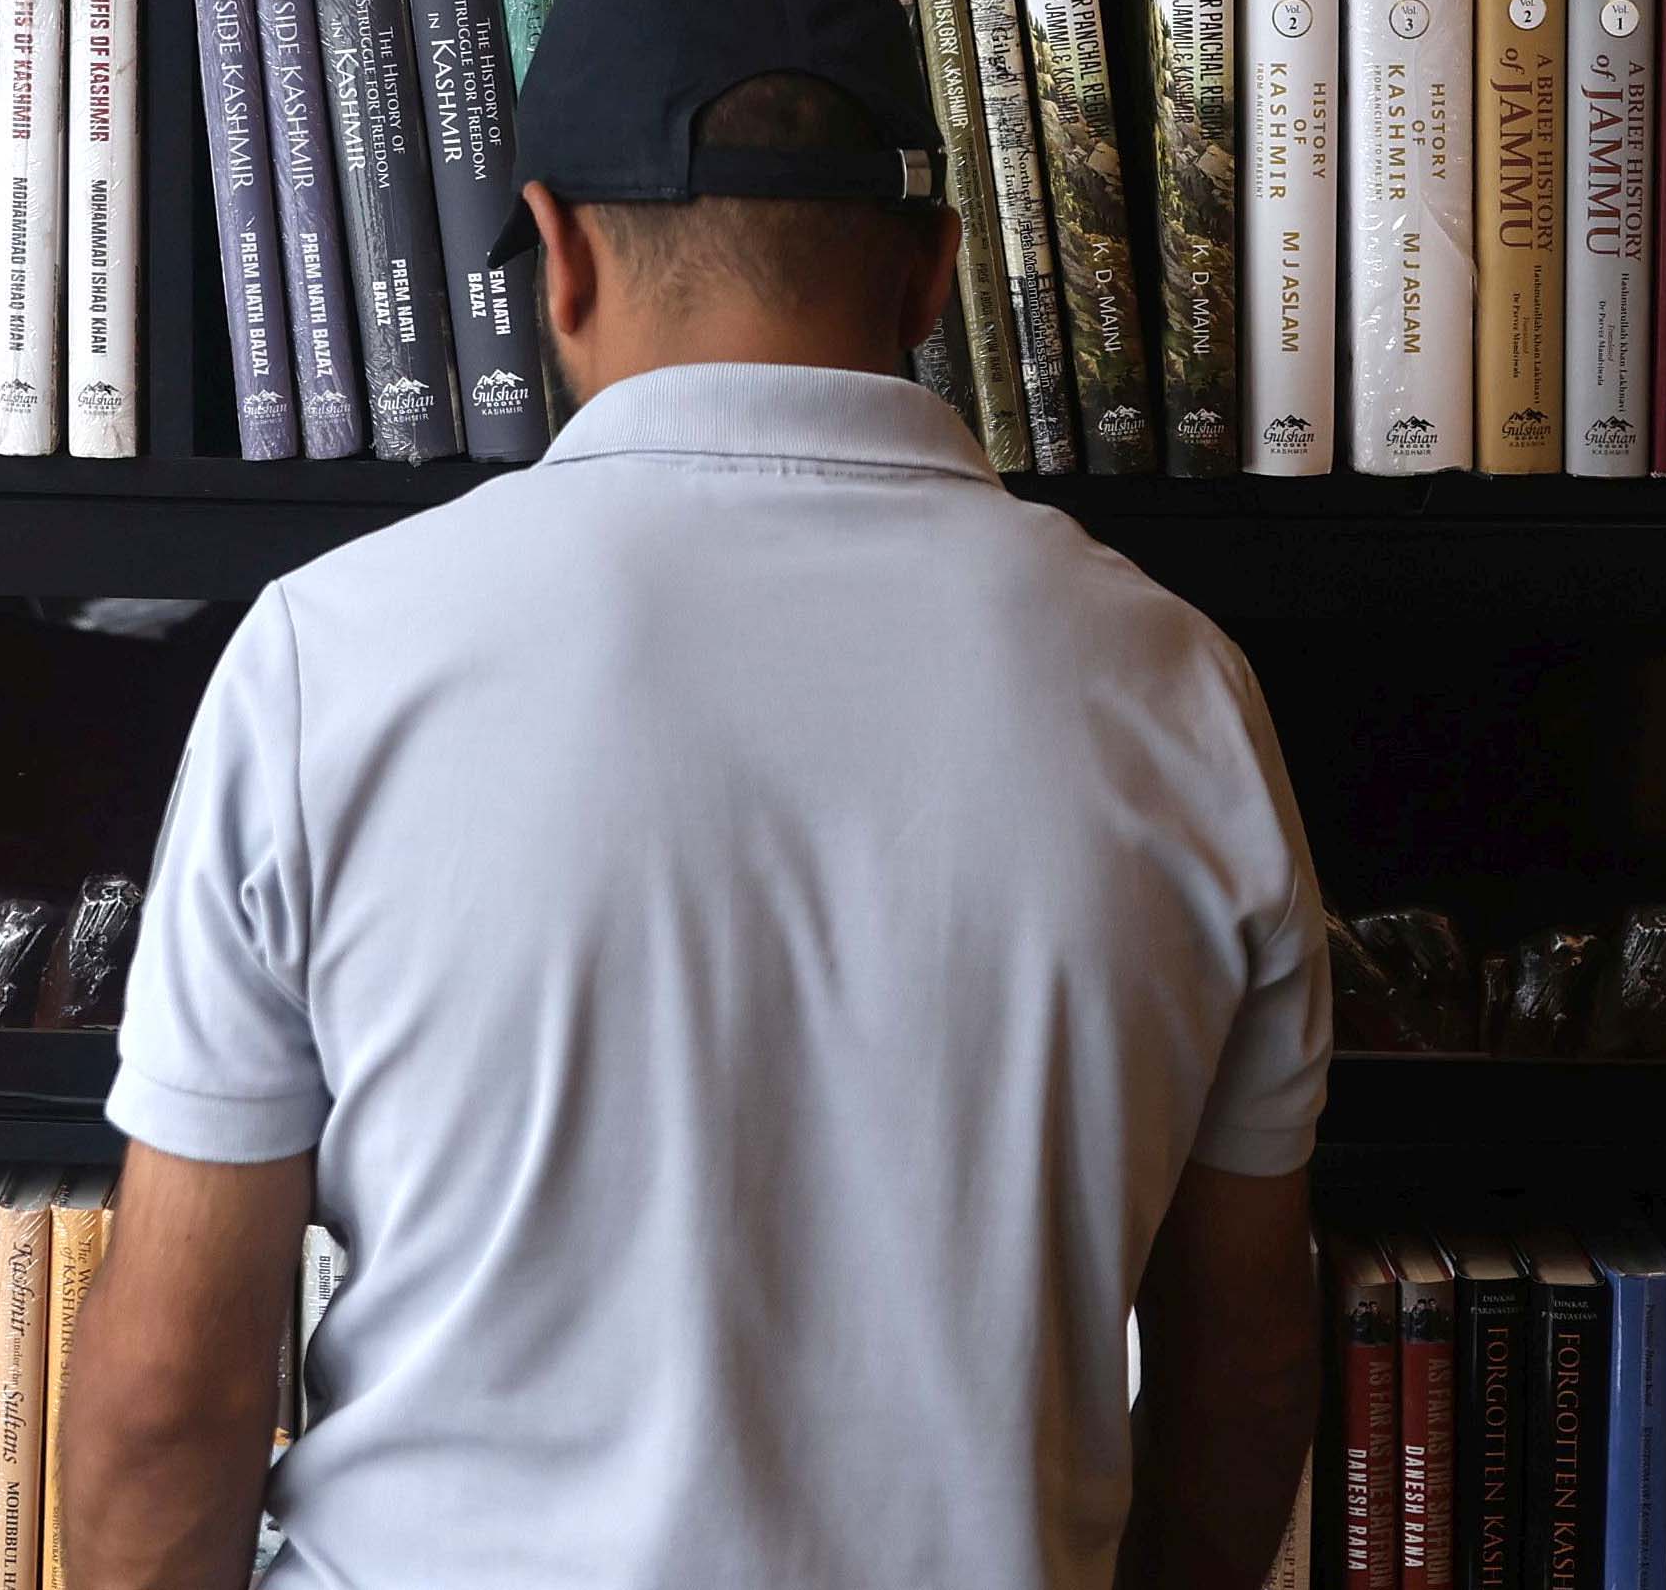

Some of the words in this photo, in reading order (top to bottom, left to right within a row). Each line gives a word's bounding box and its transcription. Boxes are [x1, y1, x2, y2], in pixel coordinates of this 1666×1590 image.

[1596, 54, 1617, 81] of
[1628, 61, 1644, 74] A
[280, 65, 315, 191] KASHMIR
[1270, 63, 1287, 198] KASHMIR
[1293, 119, 1307, 145] OF
[1312, 83, 1326, 178] HISTORY
[1627, 84, 1644, 150] BRIEF
[1582, 85, 1623, 257] JAMMU
[1625, 159, 1643, 260] HISTORY
[300, 233, 320, 279] PREM
[1283, 231, 1299, 251] M
[1283, 259, 1299, 268] J
[304, 283, 326, 323] NATH
[1282, 275, 1299, 351] ASLAM
[308, 328, 333, 377] BAZAZ
[1554, 1333, 1580, 1508] FORGOTTEN
[1405, 1445, 1424, 1513] DANESH
[1405, 1522, 1424, 1567] RANA
